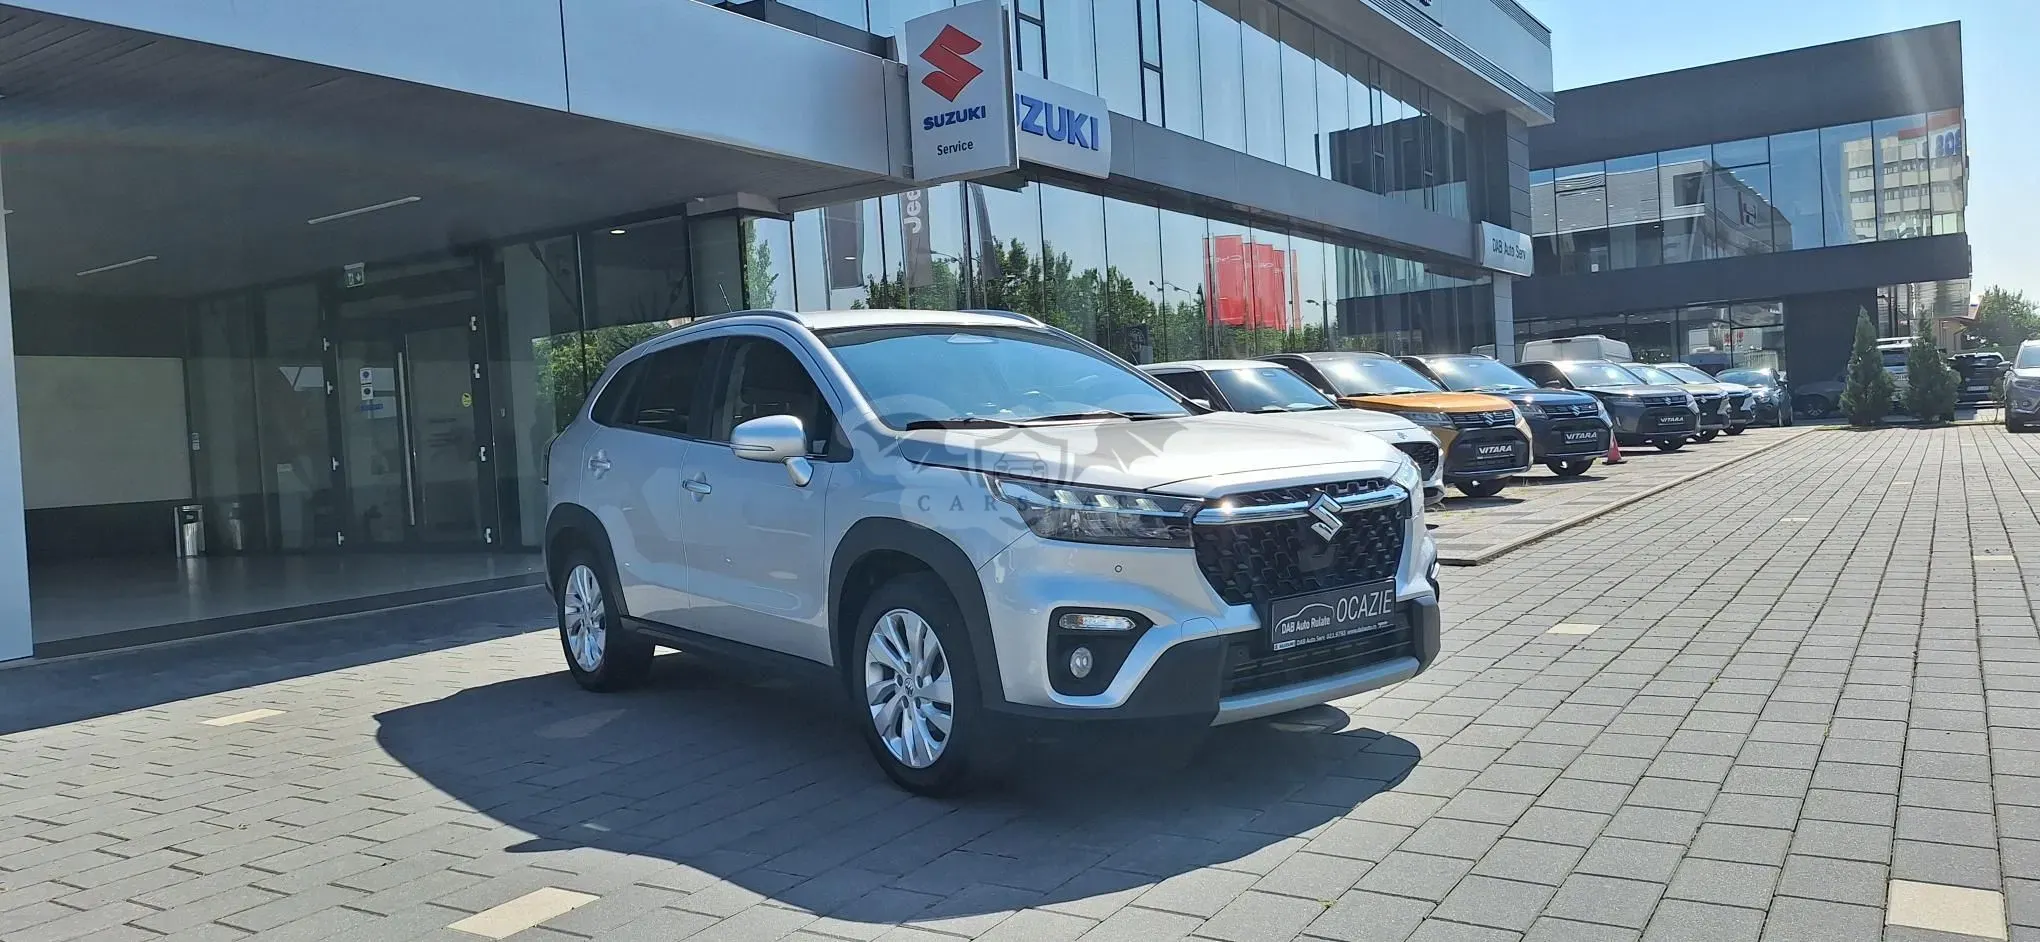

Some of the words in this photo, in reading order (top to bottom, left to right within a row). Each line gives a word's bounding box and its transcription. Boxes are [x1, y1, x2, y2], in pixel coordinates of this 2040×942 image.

[923, 105, 986, 130] SUZUKI
[1015, 93, 1099, 151] ZUKI
[937, 140, 974, 156] Service
[903, 189, 921, 234] Jee
[1492, 237, 1503, 254] DAB
[1504, 241, 1515, 257] Auto
[1515, 244, 1526, 261] Serv
[1565, 431, 1597, 440] VITARA
[1479, 445, 1512, 454] VITARA
[1336, 589, 1393, 623] OCAZIE
[1281, 622, 1295, 634] DAB
[1295, 620, 1310, 631] Auto
[1310, 616, 1330, 628] Rulate
